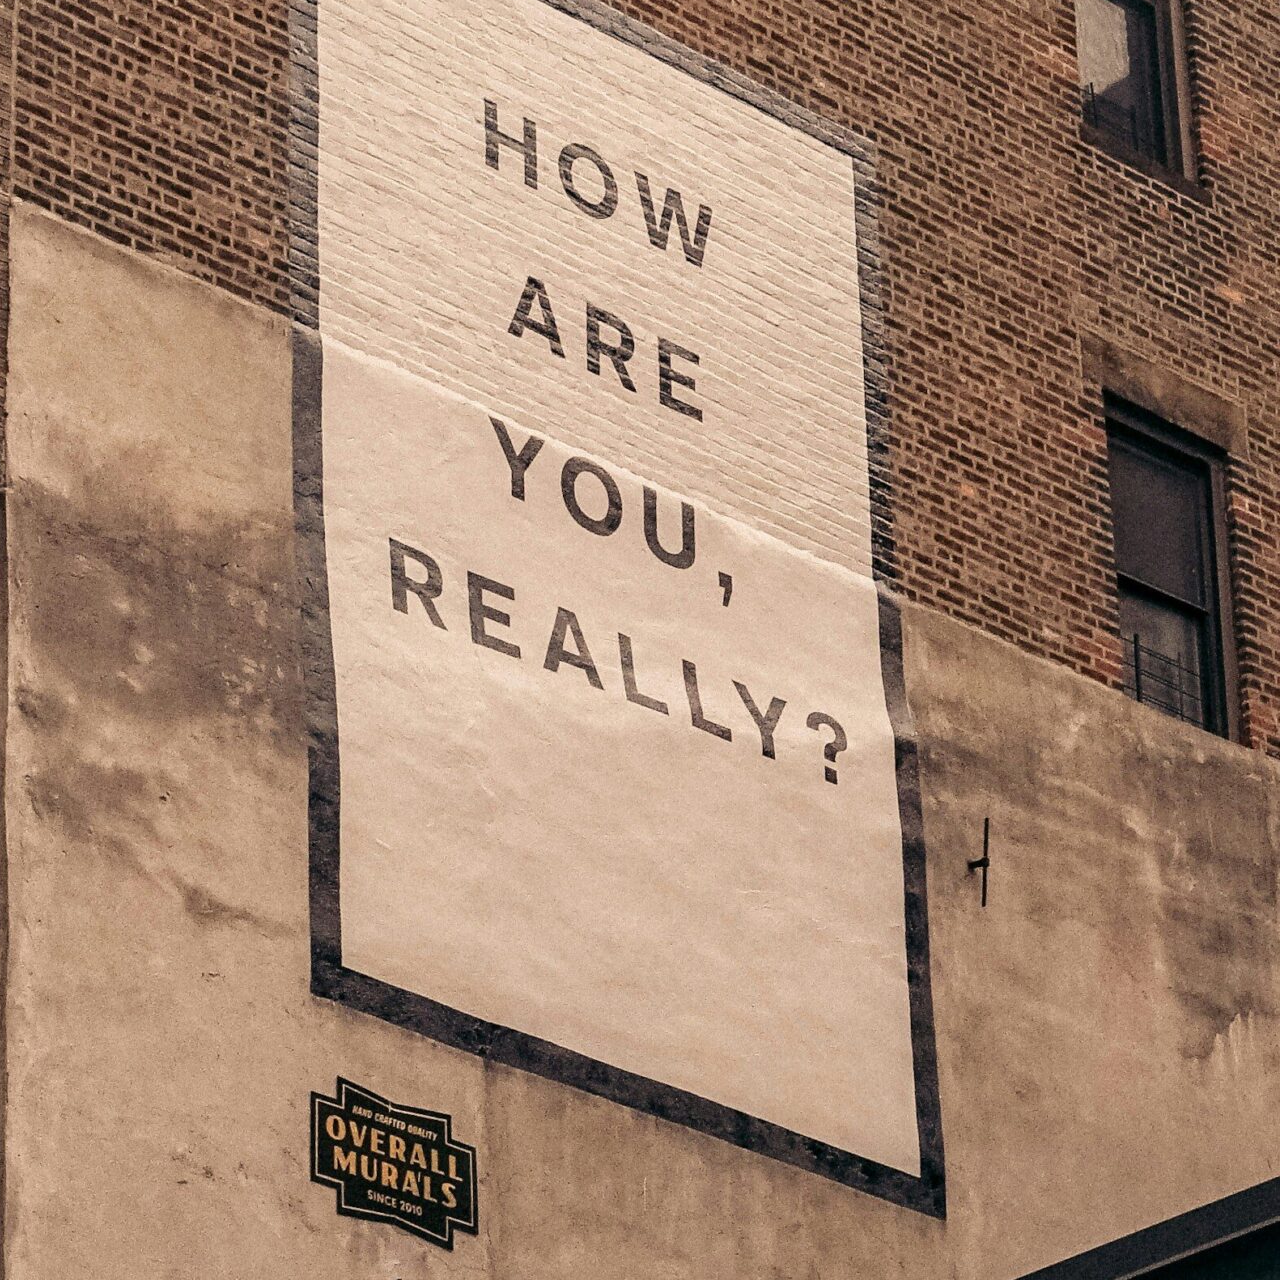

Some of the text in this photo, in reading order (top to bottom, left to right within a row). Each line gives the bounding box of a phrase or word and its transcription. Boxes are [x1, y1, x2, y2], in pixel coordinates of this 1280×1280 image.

[484, 97, 713, 267] HOW
[507, 276, 703, 422] ARE
[488, 416, 734, 609] YOU,
[388, 537, 849, 786] REALLY?
[325, 1114, 464, 1182] OVERALL
[351, 1105, 438, 1141] HAND CRAFTED QUALITY
[333, 1145, 458, 1209] MURALS
[367, 1189, 423, 1216] SINCE 2010
